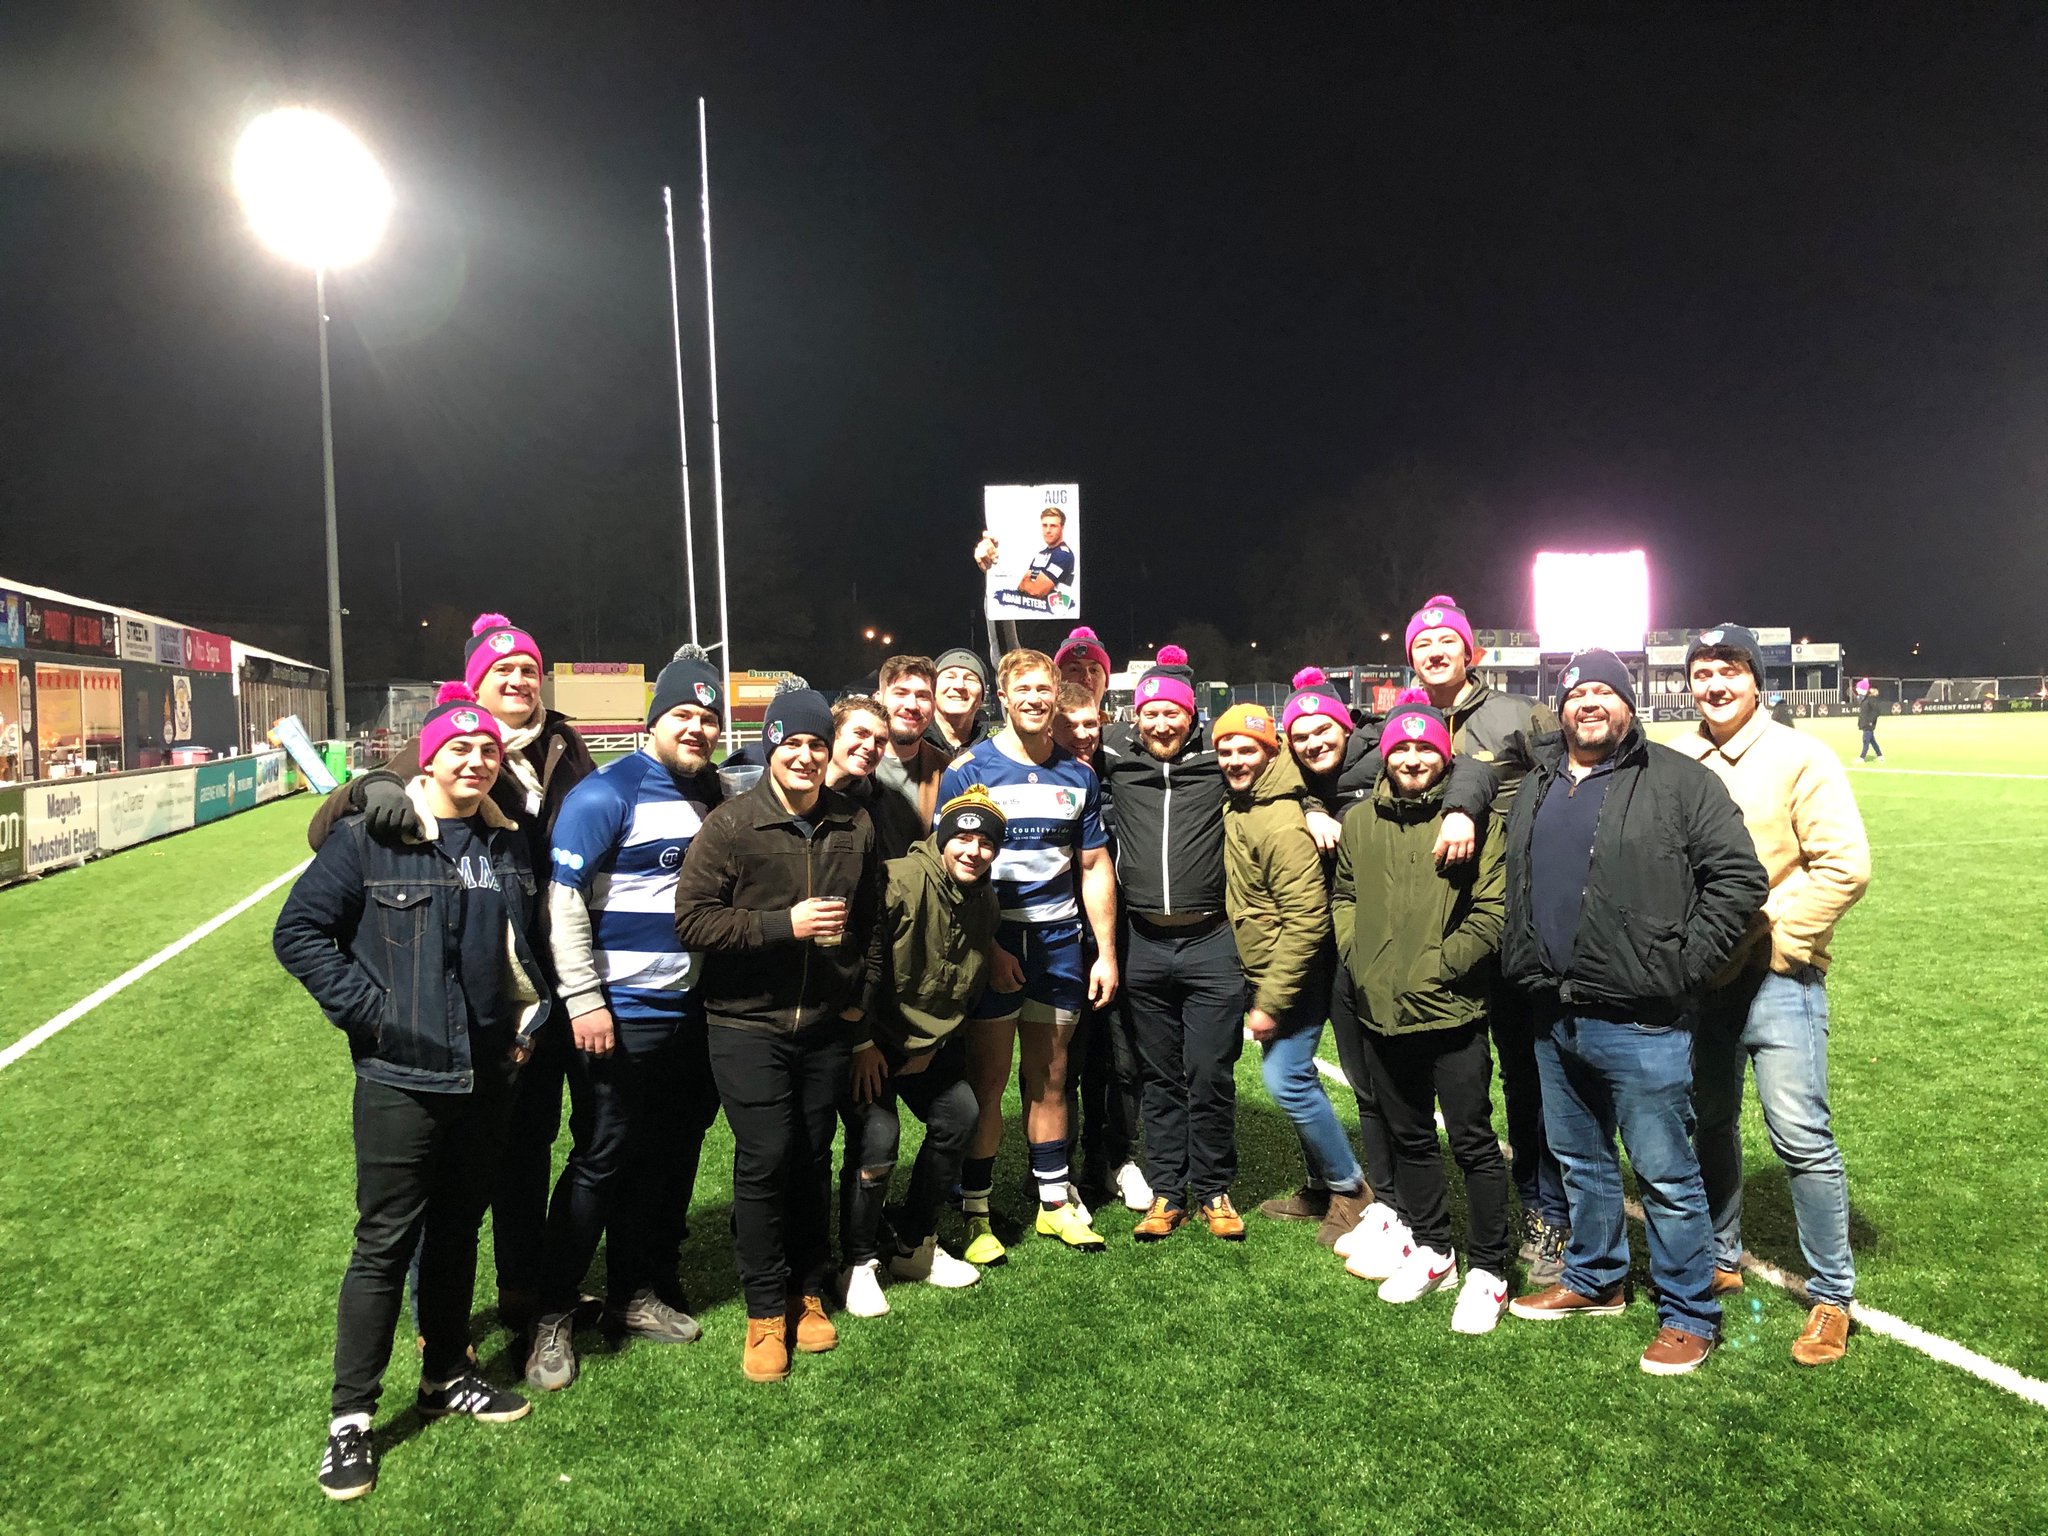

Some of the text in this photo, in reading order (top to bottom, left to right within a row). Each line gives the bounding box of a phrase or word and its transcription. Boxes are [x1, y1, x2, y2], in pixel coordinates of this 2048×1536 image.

[1045, 490, 1067, 504] AUG
[573, 662, 628, 673] SWEETS
[749, 670, 790, 679] Burgers
[47, 791, 81, 824] Maguire
[28, 827, 96, 866] Industrial Estate
